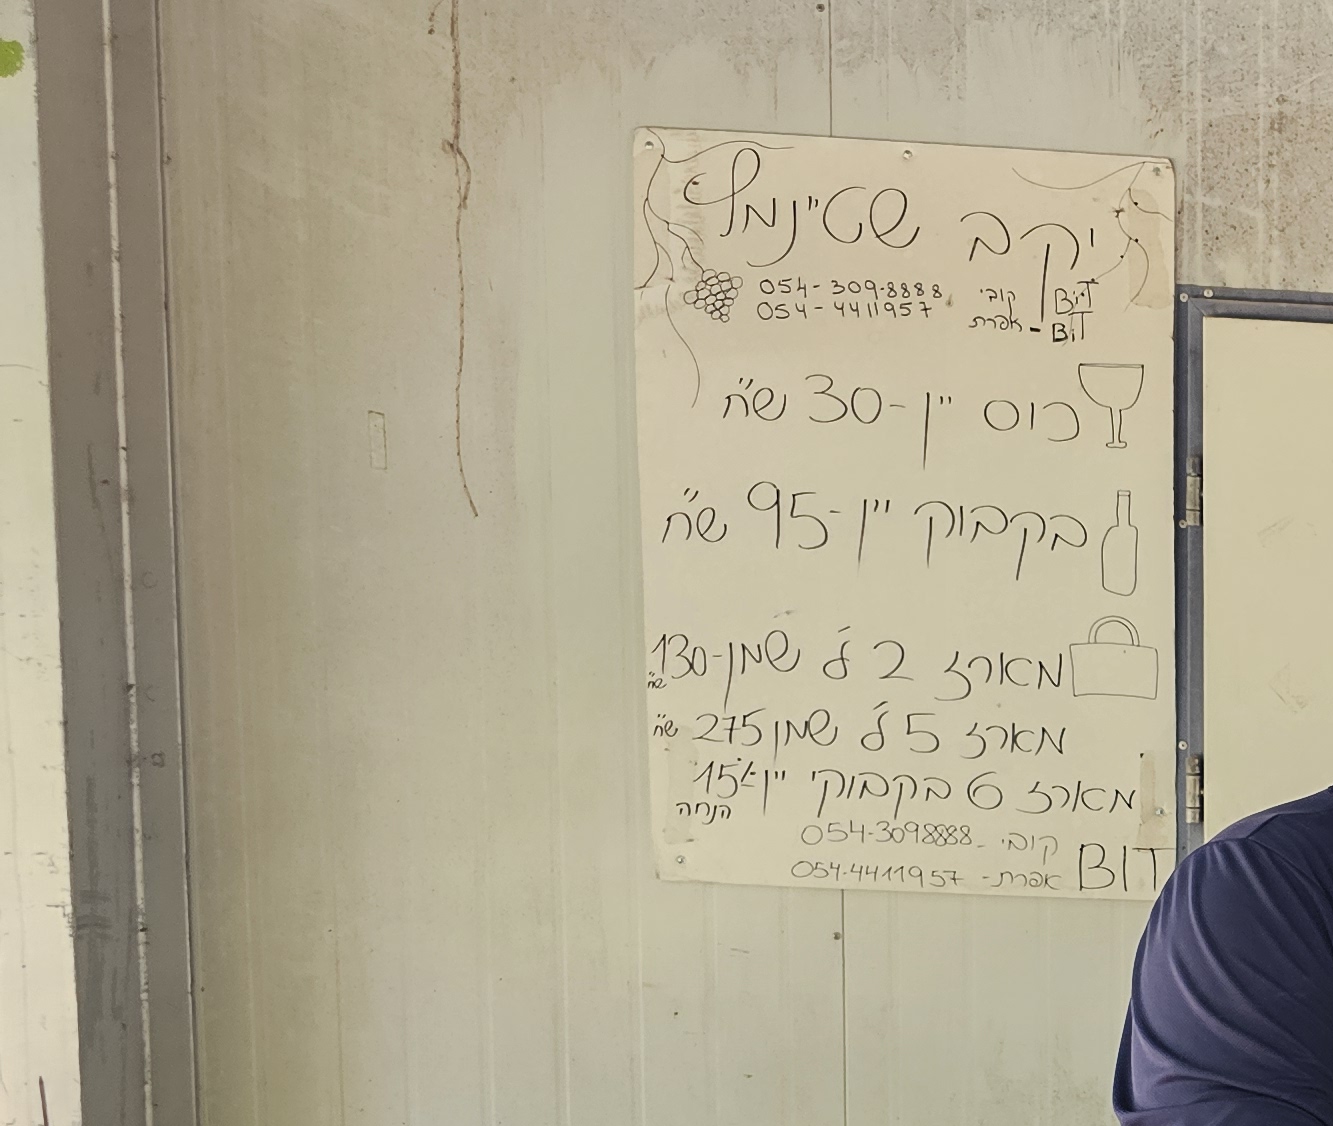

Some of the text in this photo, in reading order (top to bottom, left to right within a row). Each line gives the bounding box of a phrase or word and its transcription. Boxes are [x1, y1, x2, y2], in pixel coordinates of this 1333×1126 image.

[960, 212, 1096, 323] יקב
[984, 400, 1080, 443] כוס
[914, 500, 1088, 582] בקבוק
[873, 640, 914, 681] 2
[935, 651, 1063, 702] מארז
[692, 709, 768, 747] 275
[774, 709, 839, 764] שמן
[906, 713, 940, 754] 5
[960, 722, 1067, 760] מארז
[966, 771, 1004, 811] 6
[1016, 775, 1137, 815] מארז
[1078, 843, 1176, 893] BIT
